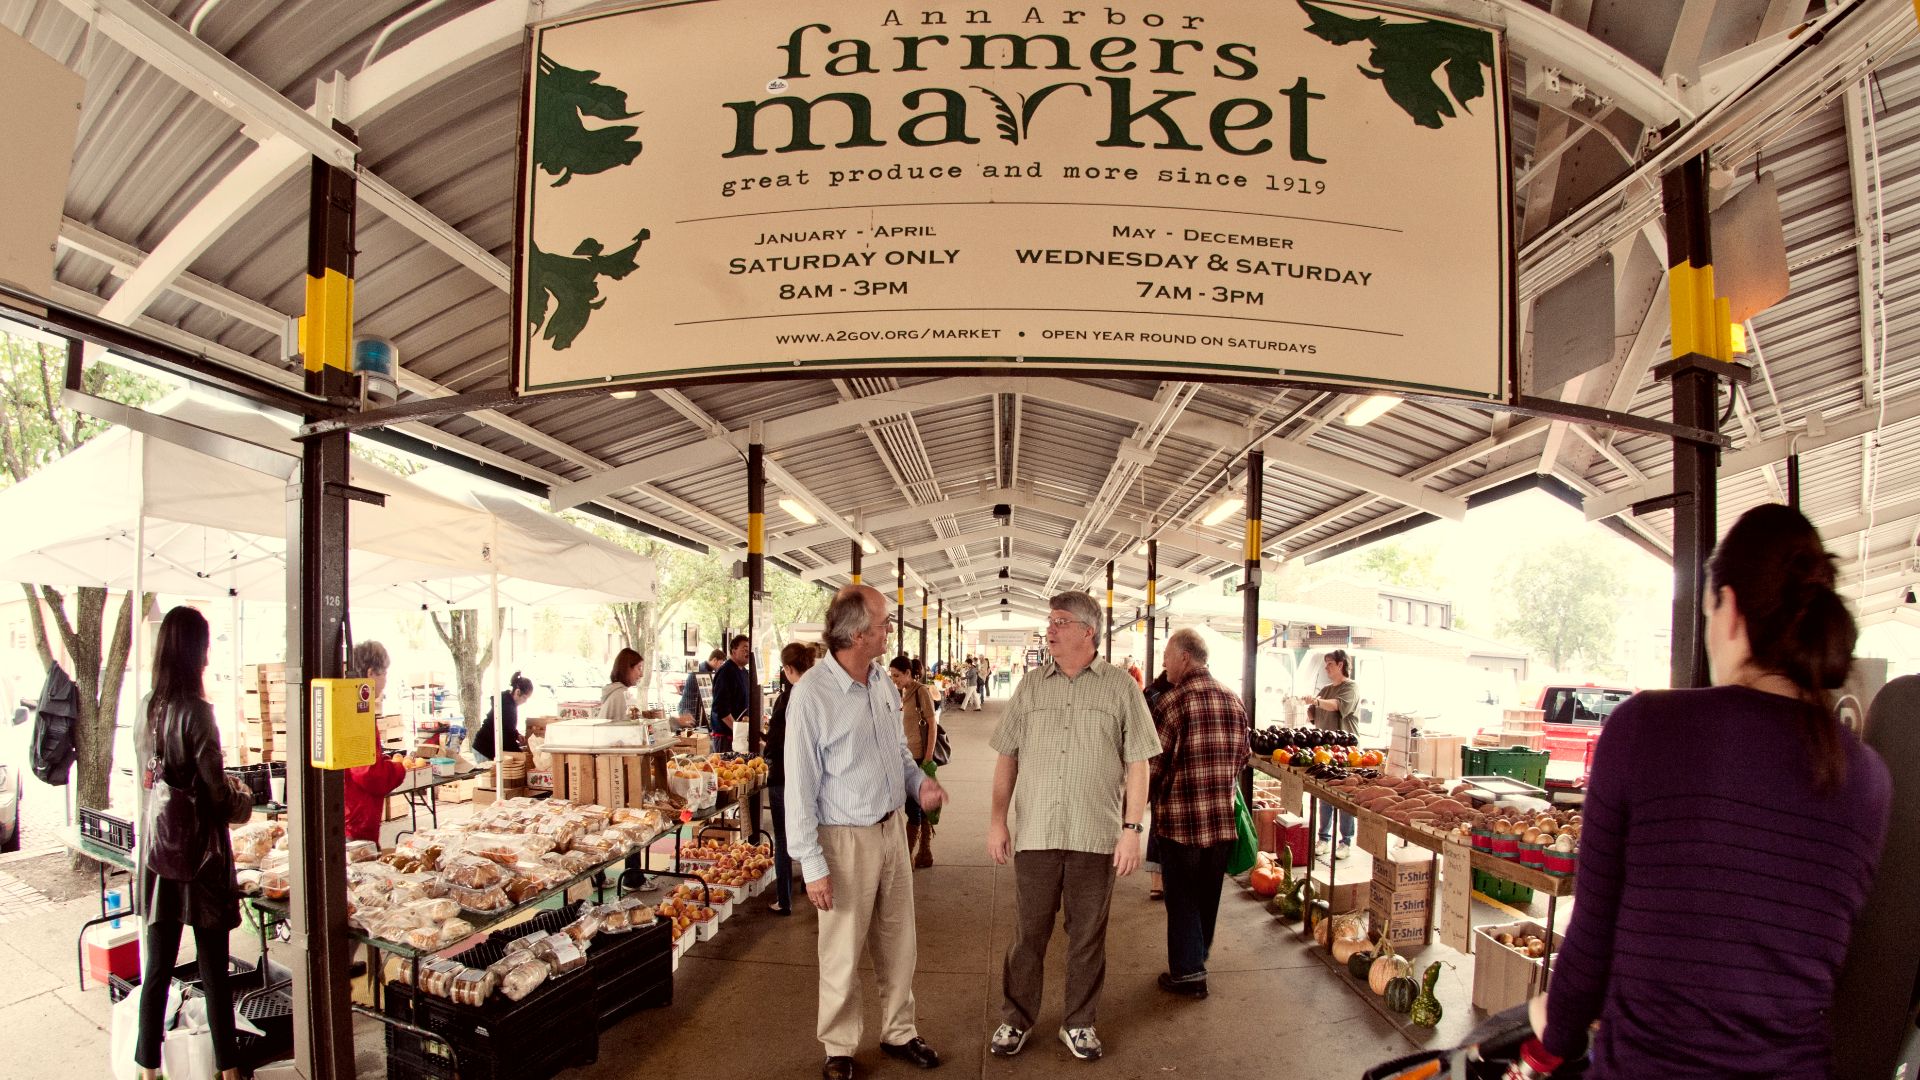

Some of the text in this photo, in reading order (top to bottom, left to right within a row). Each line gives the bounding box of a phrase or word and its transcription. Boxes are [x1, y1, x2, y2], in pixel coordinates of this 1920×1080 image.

[882, 7, 1206, 30] Ann Arbor
[777, 23, 1260, 81] farmers
[722, 76, 1328, 165] market
[721, 162, 1327, 198] great produce and more since 1919
[754, 229, 848, 246] JANUARY
[873, 225, 937, 238] APRIL
[1112, 225, 1156, 239] MAY
[1183, 229, 1294, 250] DECEMBER
[728, 249, 962, 275] SATURDAY ONLY
[1015, 248, 1373, 287] WEDNESDAY & SATURDAY
[779, 283, 834, 300] 8AM
[853, 279, 909, 296] 3PM
[1136, 281, 1193, 302] 7AM
[1211, 286, 1265, 306] 3PM
[1041, 329, 1318, 355] OPEN YEAR ROUND ON SATURDAYS
[325, 595, 341, 607] 126
[315, 689, 323, 759] EMERGENCY
[1398, 871, 1430, 883] T-Shirt
[1393, 900, 1425, 911] T-Shirt
[1391, 928, 1423, 939] T-Shirt
